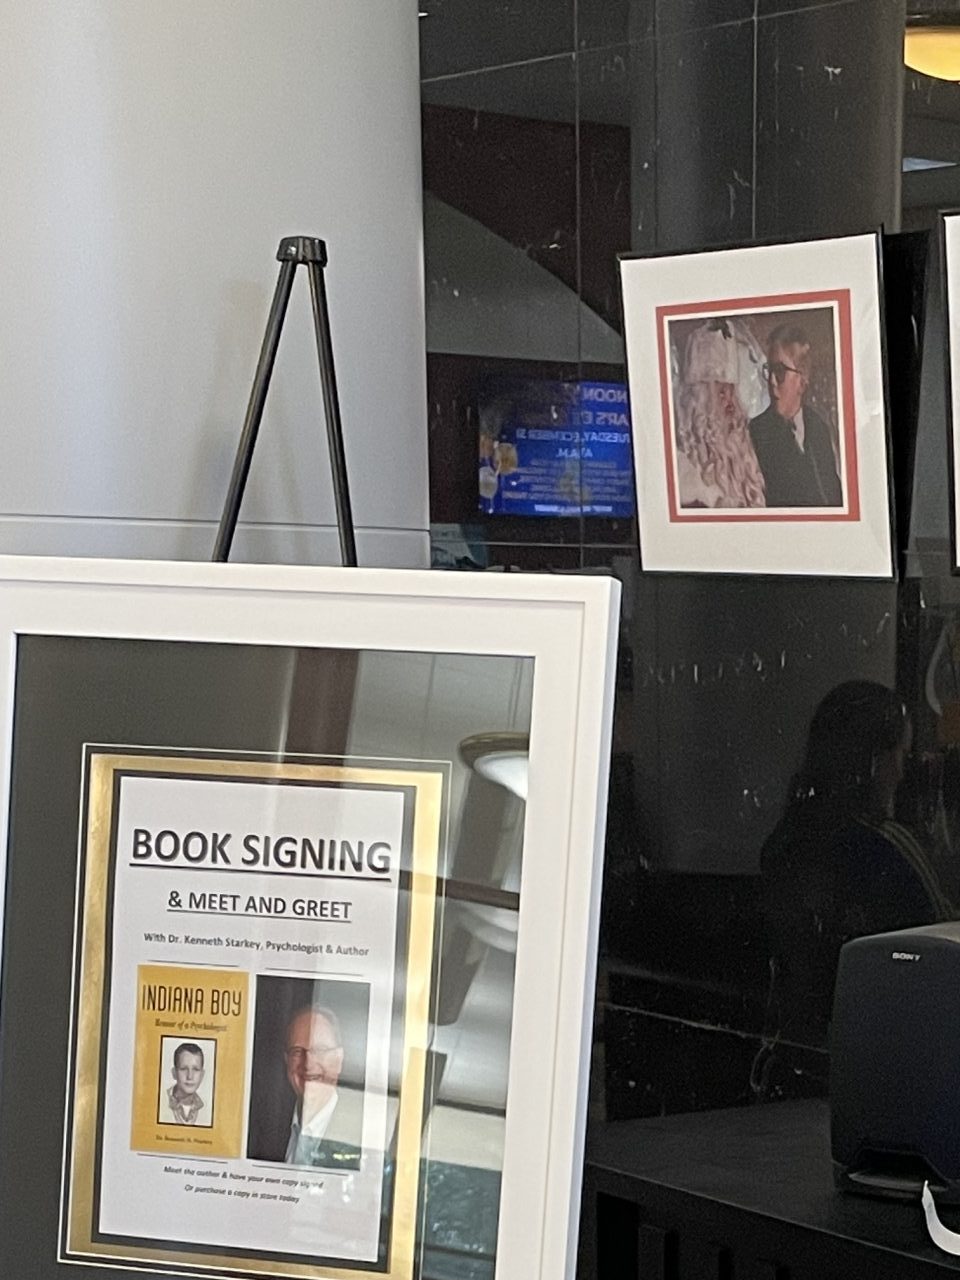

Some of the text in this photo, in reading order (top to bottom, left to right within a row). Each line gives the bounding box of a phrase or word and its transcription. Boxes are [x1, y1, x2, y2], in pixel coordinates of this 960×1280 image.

[132, 828, 390, 874] BOOK SIGNING
[168, 890, 352, 918] & MEET AND GREET
[143, 932, 369, 956] With Dr. Kenneth Starkey, Psychologist & Author
[892, 952, 921, 962] SONY
[142, 984, 242, 1017] INDIANA BOY
[183, 1183, 194, 1192] Or
[193, 1186, 227, 1195] purchase
[233, 1190, 251, 1199] copy
[259, 1192, 278, 1201] store
[278, 1194, 300, 1204] today
